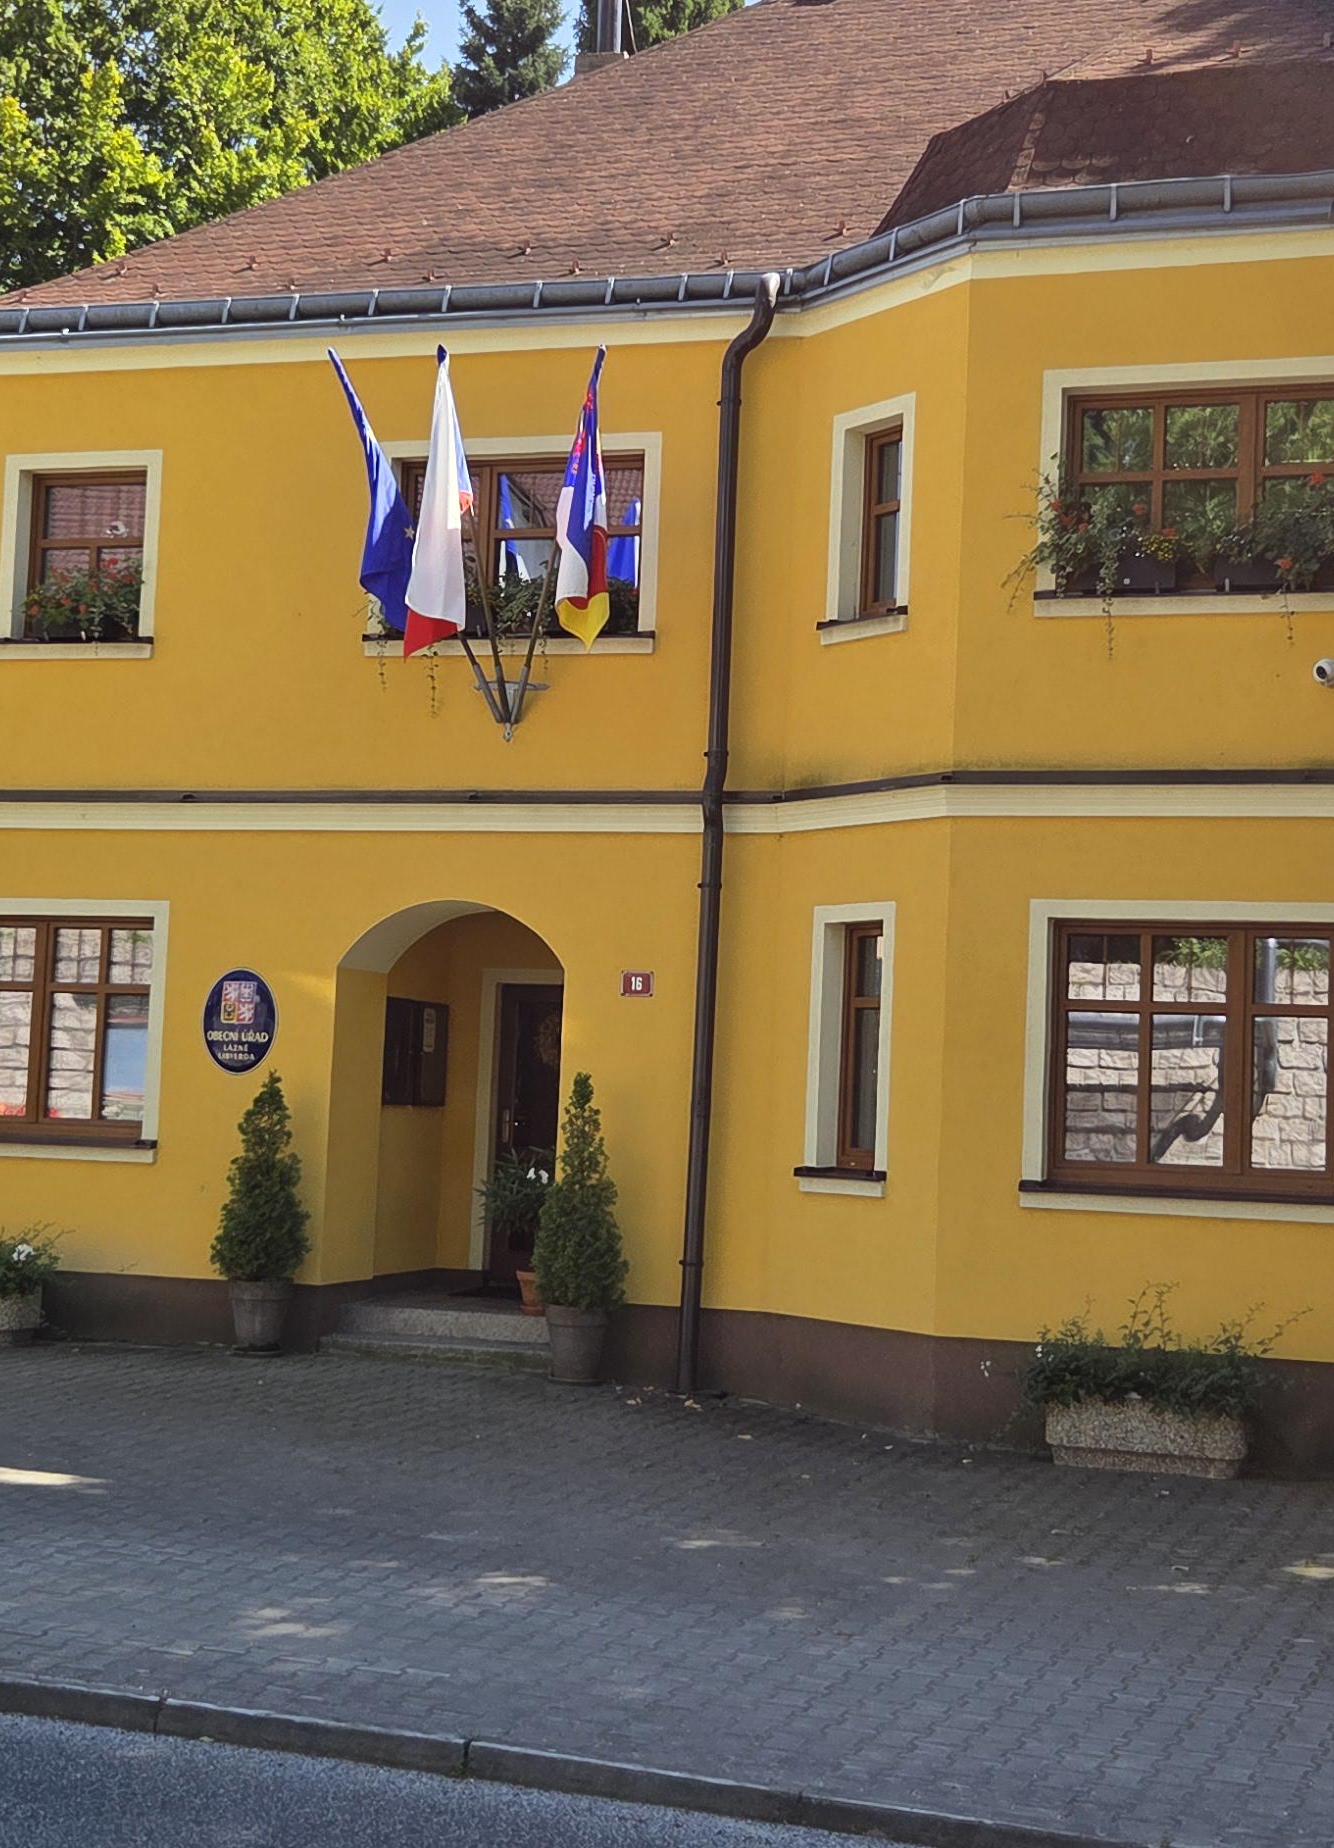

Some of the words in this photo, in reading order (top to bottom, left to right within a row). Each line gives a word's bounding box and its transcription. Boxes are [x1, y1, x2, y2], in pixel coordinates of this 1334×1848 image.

[631, 976, 643, 991] 16
[207, 1029, 239, 1041] OBECNÍ
[241, 1030, 269, 1042] ÚŘAD
